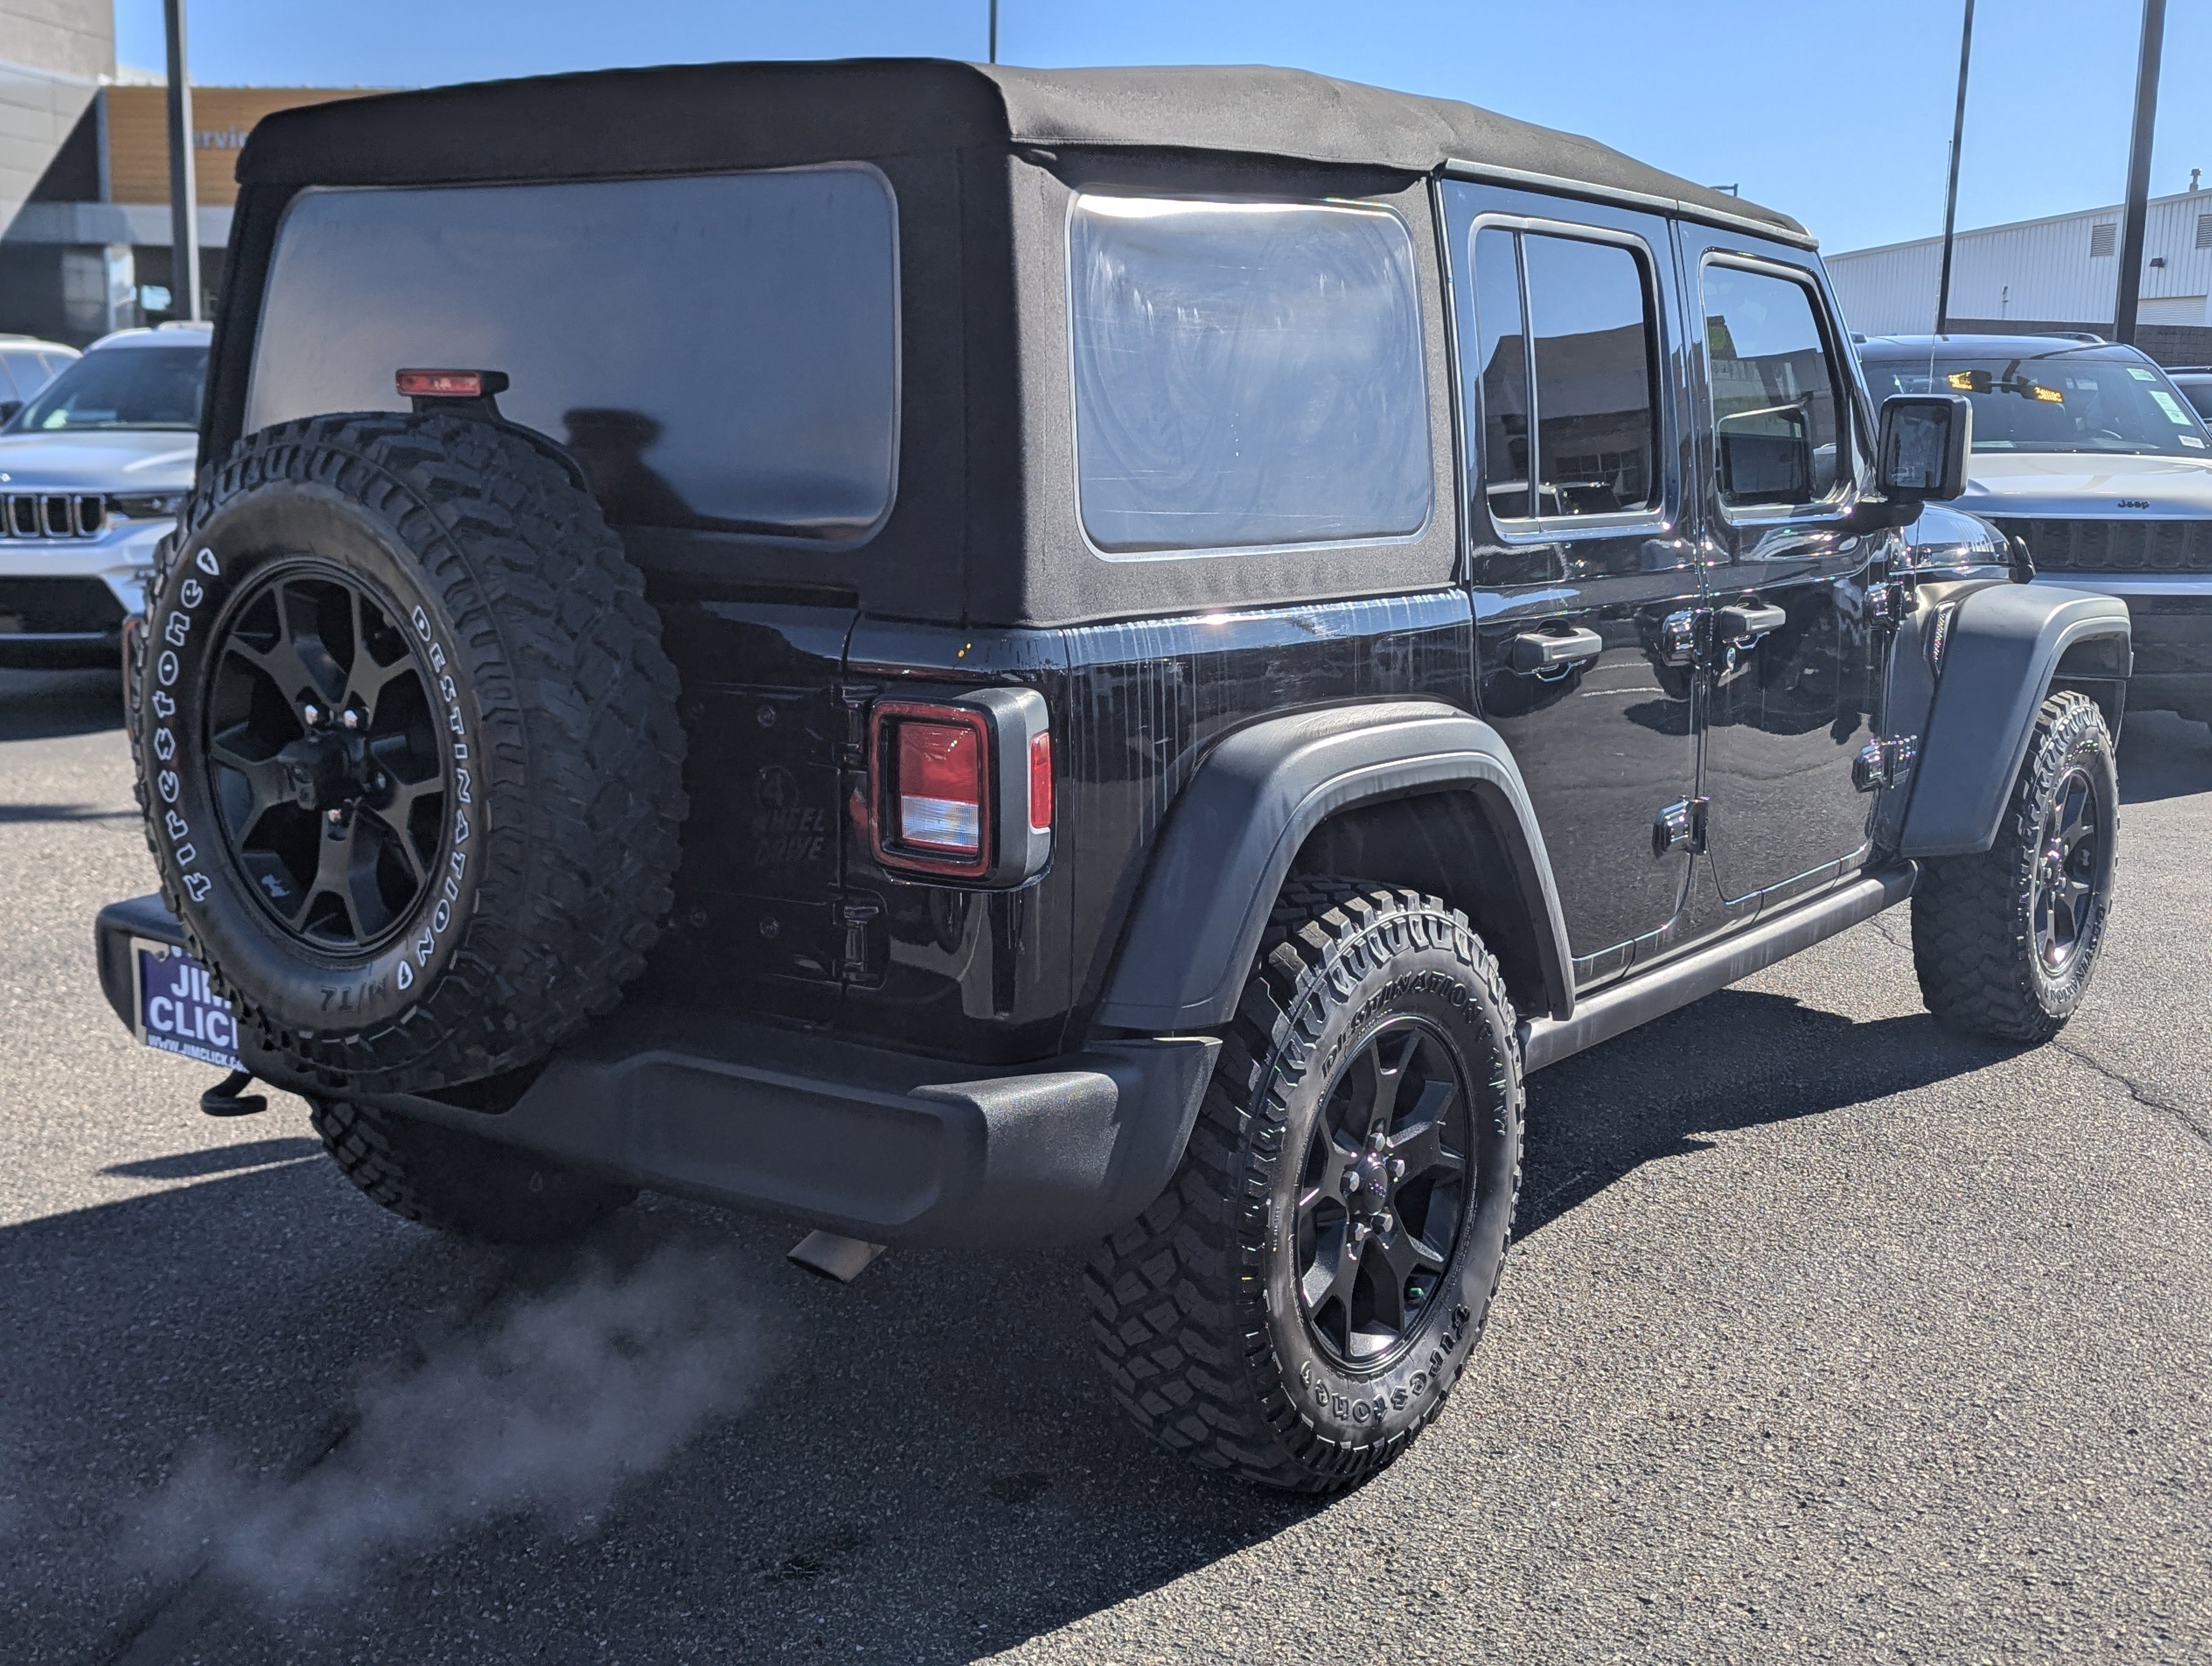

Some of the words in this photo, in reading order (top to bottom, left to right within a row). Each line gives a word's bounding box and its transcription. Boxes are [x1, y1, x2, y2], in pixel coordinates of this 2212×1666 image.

[2117, 499, 2149, 510] Jeep
[152, 578, 212, 903] Firestone
[411, 605, 471, 967] DESTINATION
[149, 996, 239, 1050] CLIC
